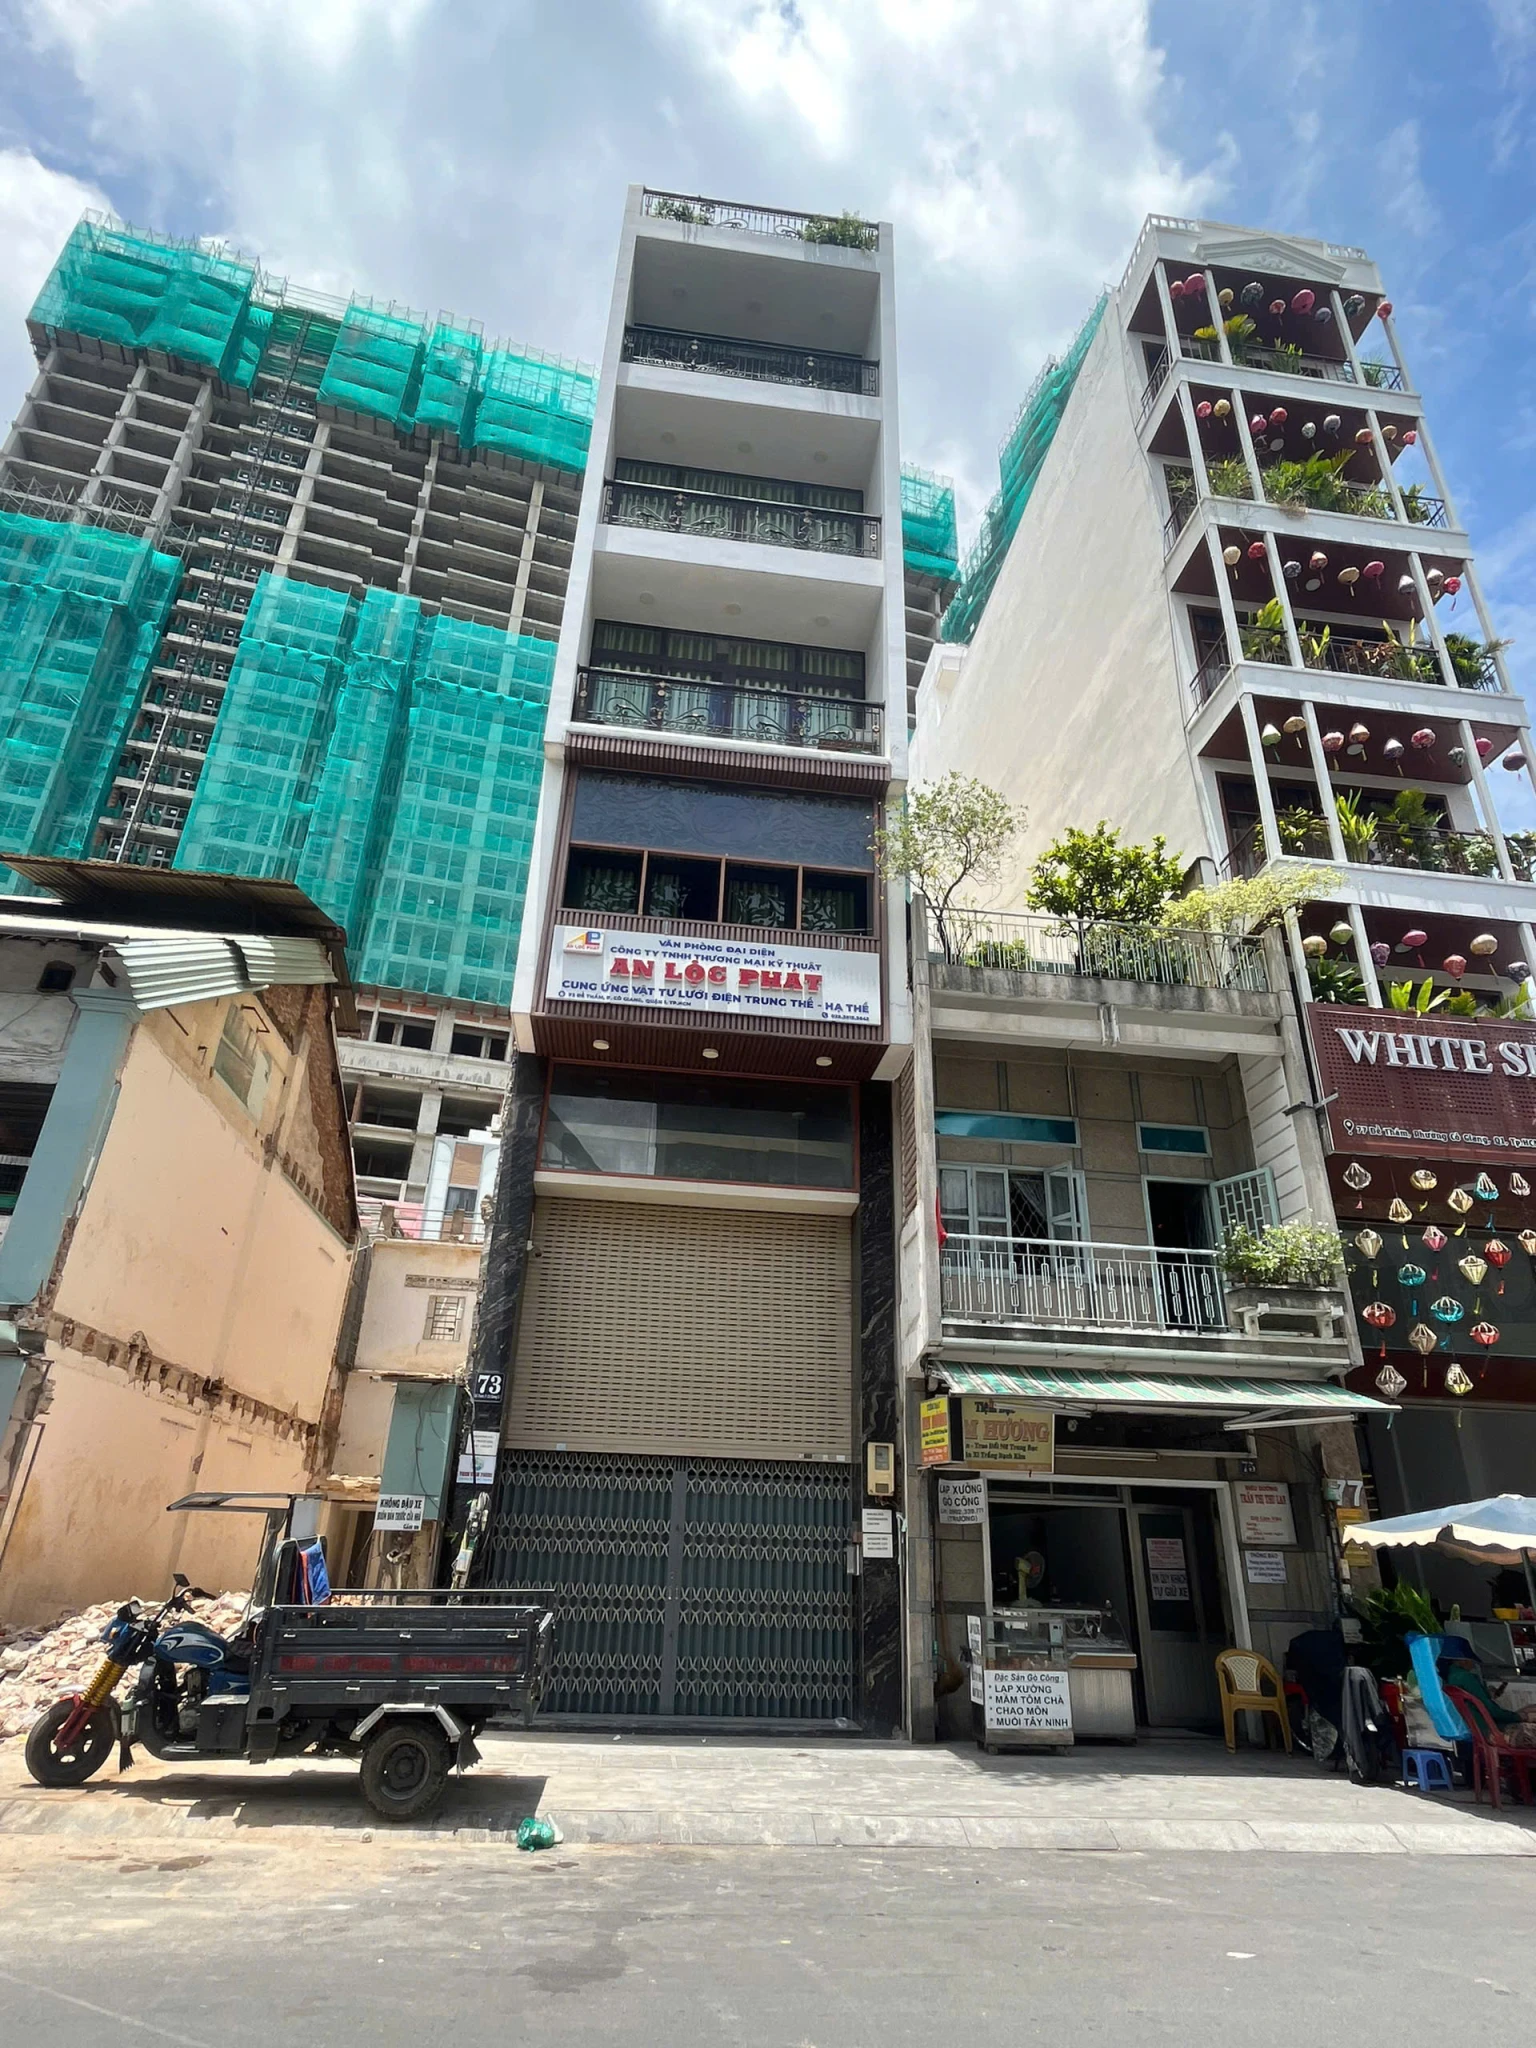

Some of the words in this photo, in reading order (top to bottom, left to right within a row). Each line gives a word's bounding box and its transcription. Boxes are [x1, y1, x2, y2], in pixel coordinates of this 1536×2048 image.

[659, 939, 681, 949] VĂN
[684, 942, 723, 955] PHÒNG
[725, 946, 746, 956] ĐẠI
[750, 948, 776, 958] DIỆN
[610, 945, 642, 956] CÔNG
[645, 949, 660, 957] TY
[662, 951, 692, 960] TNHH
[694, 953, 741, 965] THƯƠNG
[744, 958, 766, 968] MẠI
[768, 958, 784, 968] KỸ
[785, 961, 822, 973] THUẬT
[610, 957, 655, 979] AN
[664, 959, 728, 988] LỘC
[738, 968, 823, 993] PHÁT
[562, 980, 597, 991] CUNG
[601, 982, 629, 994] ỨNG
[632, 985, 655, 998] VẬT
[658, 988, 677, 997] TƯ
[678, 988, 708, 1001] LƯỚI
[711, 992, 742, 1005] ĐIỆN
[744, 995, 787, 1007] TRUNG
[790, 996, 814, 1009] THẾ
[825, 1002, 843, 1013] HẠ
[846, 1001, 870, 1013] THẾ
[1334, 1028, 1494, 1075] WHITE
[1356, 1125, 1368, 1135] 77
[1413, 1128, 1448, 1142] Phường
[477, 1374, 502, 1395] 73
[982, 1418, 1050, 1443] HƯƠNG
[954, 1495, 980, 1507] CÔNG
[1336, 1479, 1364, 1507] 77
[380, 1497, 400, 1509] KHÔNG
[400, 1497, 414, 1510] ĐẬU
[414, 1500, 423, 1509] XE
[1178, 1587, 1189, 1598] XE
[994, 1673, 1009, 1683] Đặc
[1039, 1673, 1060, 1684] Công
[1020, 1694, 1042, 1705] TÔM
[995, 1706, 1025, 1716] CHAO
[1026, 1705, 1049, 1716] MÔN
[1045, 1719, 1069, 1728] NINH
